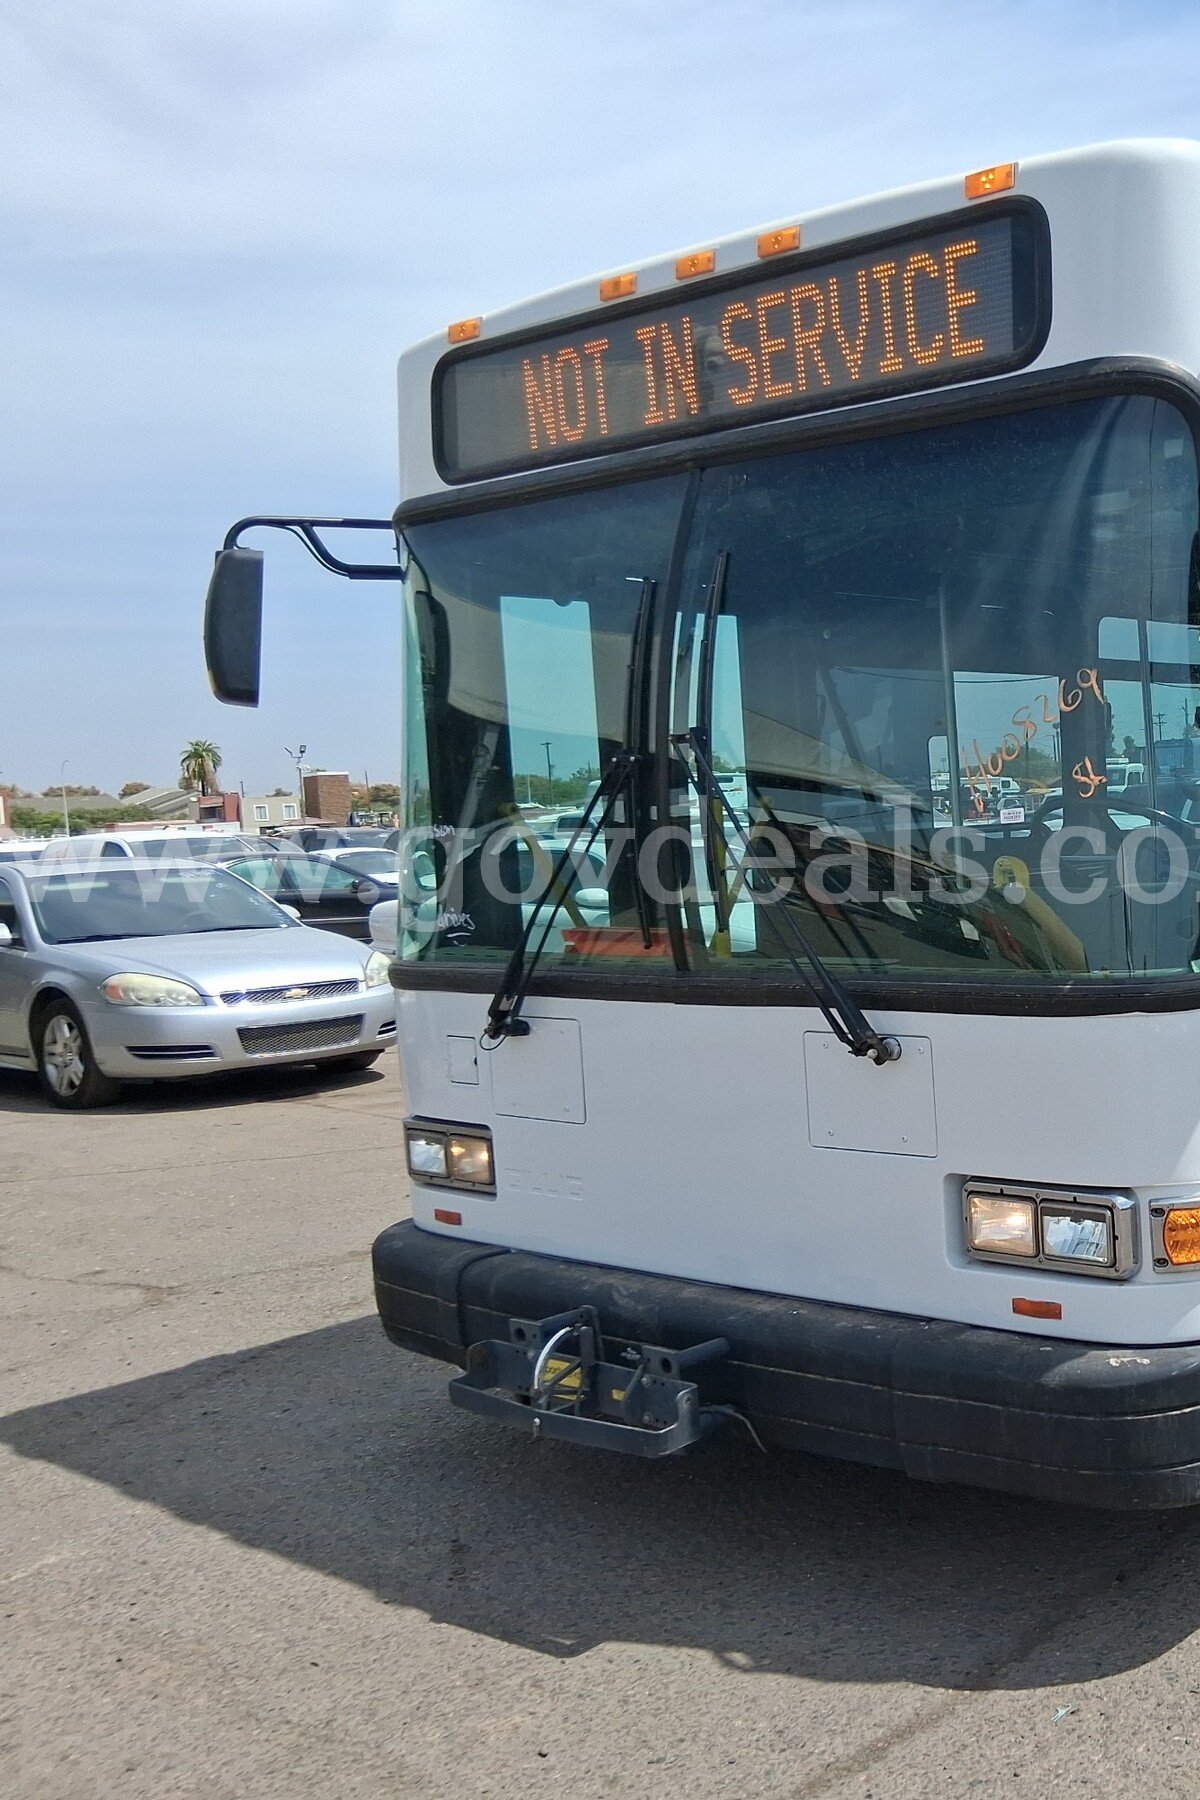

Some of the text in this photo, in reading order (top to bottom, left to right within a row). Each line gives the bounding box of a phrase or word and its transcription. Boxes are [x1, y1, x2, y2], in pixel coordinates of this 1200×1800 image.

[523, 240, 985, 450] NOT IN SERVICE
